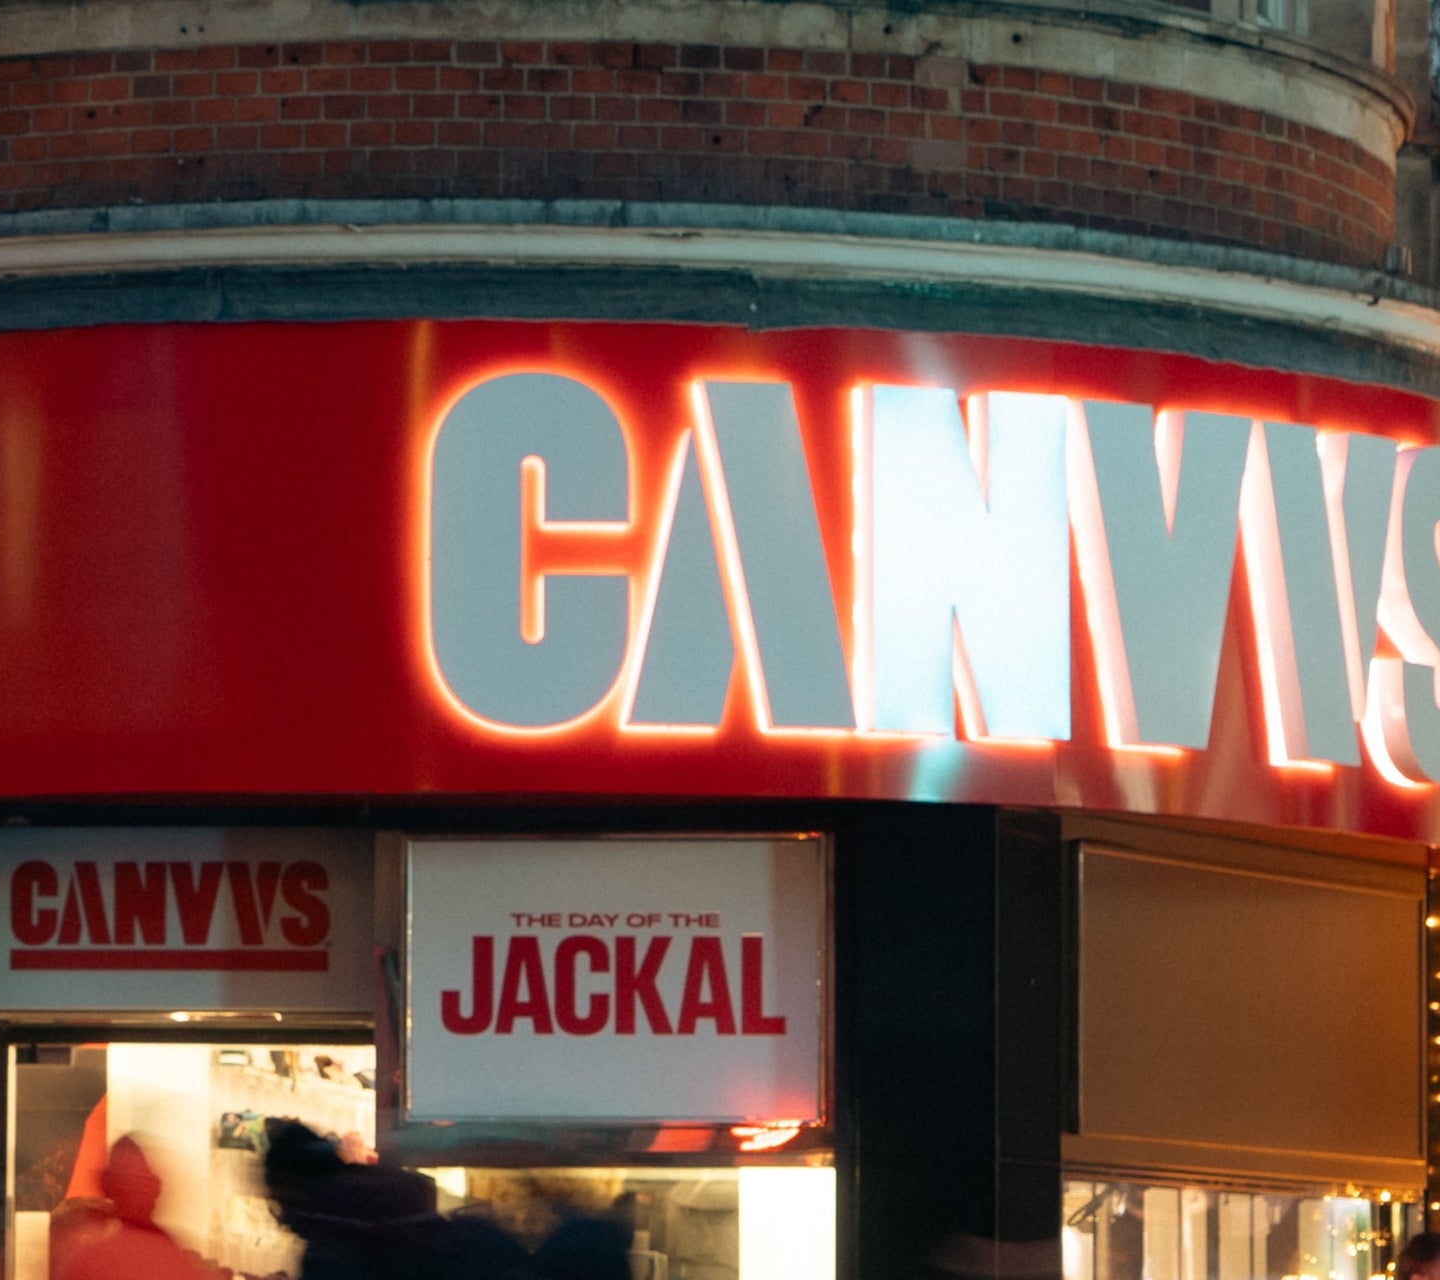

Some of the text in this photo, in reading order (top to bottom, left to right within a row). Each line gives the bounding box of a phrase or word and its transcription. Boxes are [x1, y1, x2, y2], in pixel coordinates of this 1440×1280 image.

[510, 912, 721, 929] THE DAY OF THE
[440, 934, 787, 1036] JACKAL
